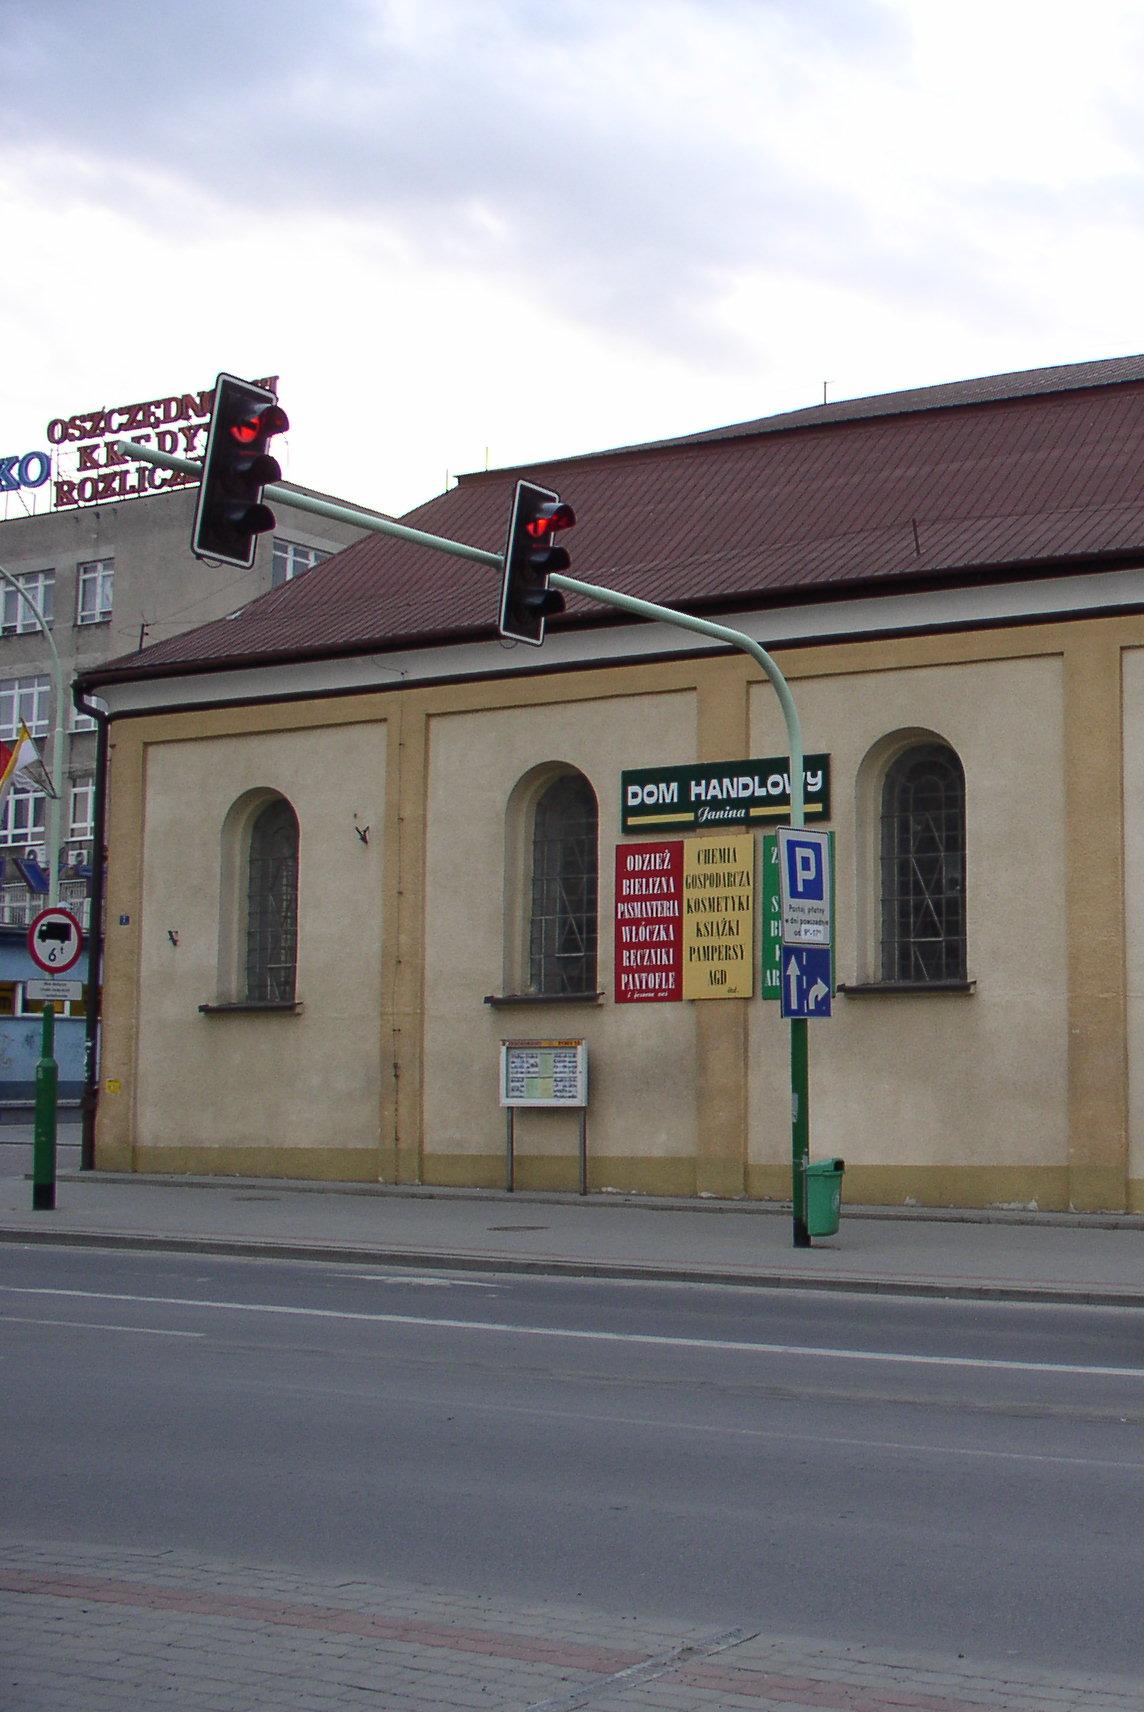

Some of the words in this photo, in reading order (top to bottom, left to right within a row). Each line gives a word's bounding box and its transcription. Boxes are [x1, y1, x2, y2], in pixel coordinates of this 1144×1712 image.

[627, 782, 678, 806] DOM
[698, 806, 745, 823] Janina
[626, 849, 671, 871] ODZIEŻ
[697, 847, 737, 865] CHEMIA
[795, 847, 816, 892] P
[623, 876, 675, 895] BIELIZNA
[686, 870, 751, 889] GOSPODARCZA
[617, 899, 679, 919] PASMANTERIA
[687, 895, 750, 914] KOSMETYKI
[689, 944, 744, 962] PAMPERSY
[621, 972, 675, 990] PANTOFLE
[709, 969, 727, 986] AGD
